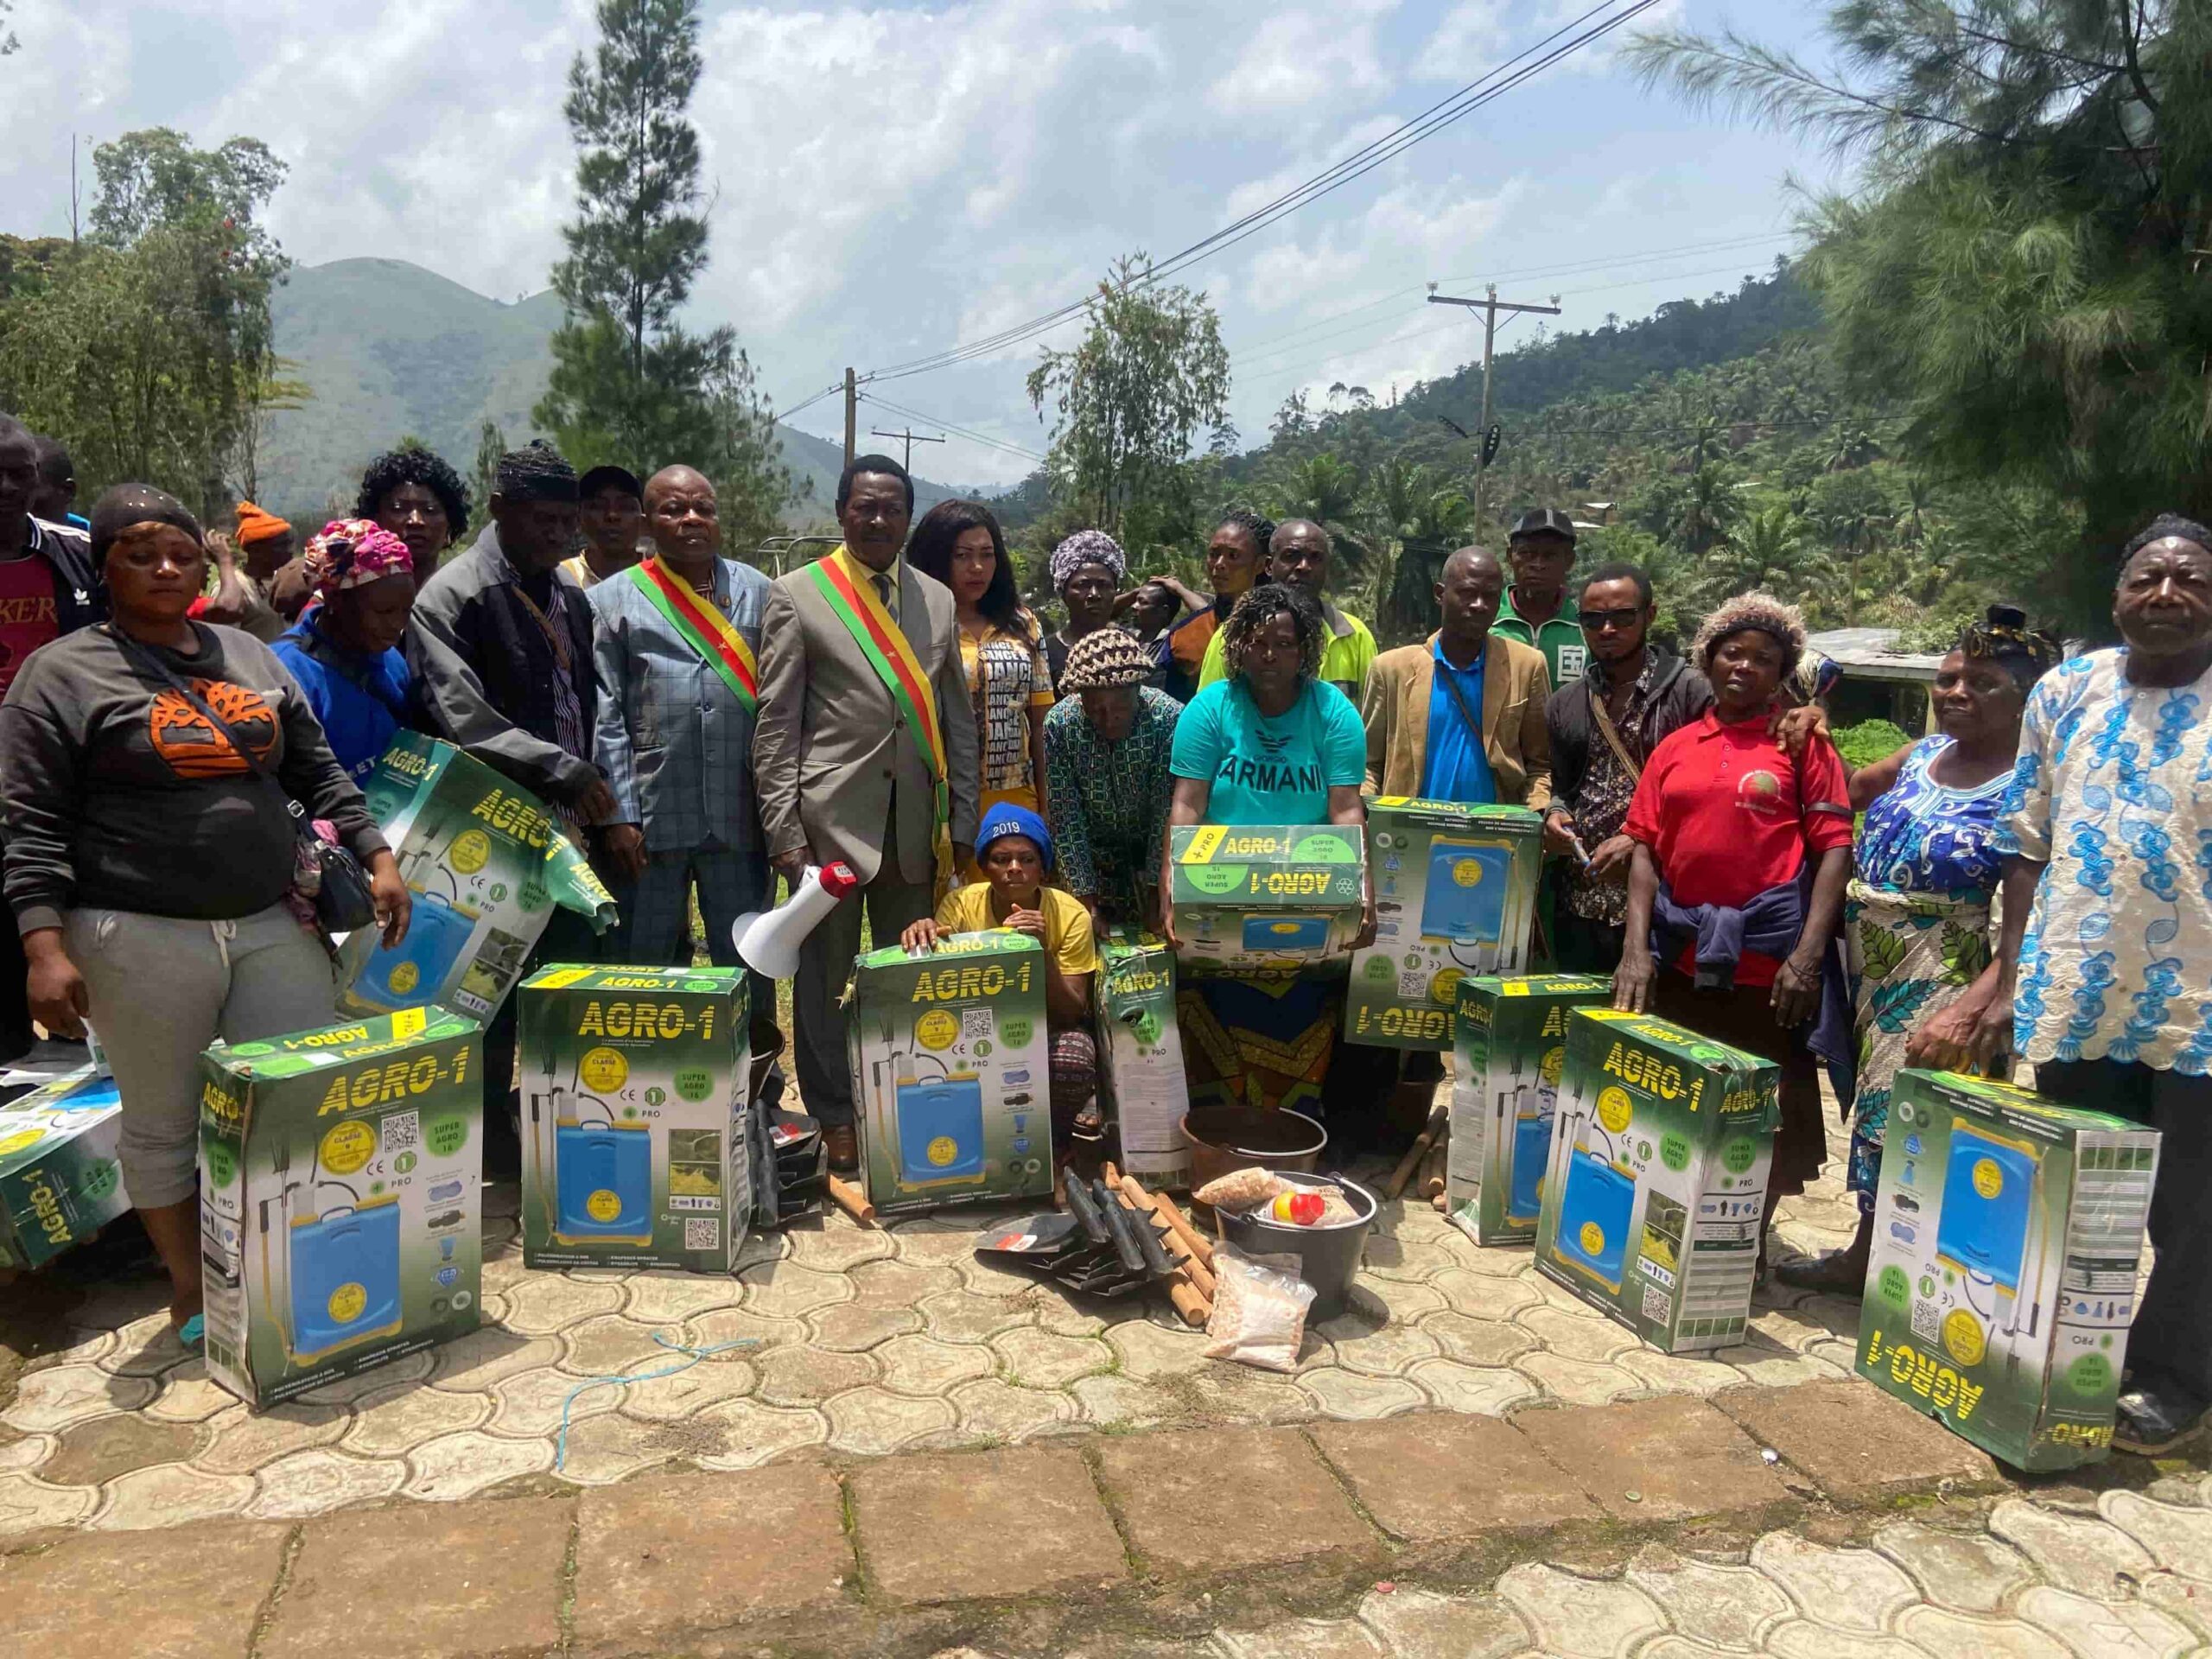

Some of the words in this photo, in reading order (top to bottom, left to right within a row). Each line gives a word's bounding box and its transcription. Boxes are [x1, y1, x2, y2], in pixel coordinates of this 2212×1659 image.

[382, 747, 439, 781] AGRO-1
[1217, 754, 1322, 794] ARMANI
[1409, 800, 1467, 812] AGRO-1
[993, 822, 1020, 837] 2019
[1201, 832, 1215, 851] PRO
[1224, 837, 1291, 855] AGRO-1
[1250, 873, 1332, 894] AGRO-1
[480, 900, 495, 912] PRO
[934, 937, 999, 955] AGRO-1
[598, 976, 677, 989] AGRO-1
[912, 961, 1031, 1003] AGRO-1
[1112, 968, 1171, 995] AGRO-1
[1544, 982, 1605, 991] AGRO-1
[577, 1001, 715, 1040] AGRO-1
[283, 1026, 370, 1050] AGRO-1
[1631, 1024, 1699, 1046] AGRO-1
[1151, 1048, 1166, 1057] PRO
[972, 1059, 988, 1068] PRO
[316, 1045, 470, 1116] AGRO-1
[1603, 1041, 1705, 1113] AGRO-1
[1719, 1087, 1773, 1114] AGRO-1
[642, 1109, 660, 1118] PRO
[435, 1122, 461, 1135] SUPER
[435, 1134, 458, 1144] AGRO
[1667, 1137, 1686, 1152] SUPER
[1632, 1160, 1646, 1173] PRO
[391, 1176, 412, 1188] PRO
[1738, 1179, 1753, 1187] PRO
[22, 1169, 73, 1243] AGRO-1
[1925, 1262, 1941, 1277] PRO
[2071, 1335, 2094, 1346] PRO
[1866, 1330, 1984, 1421] AGRO-1
